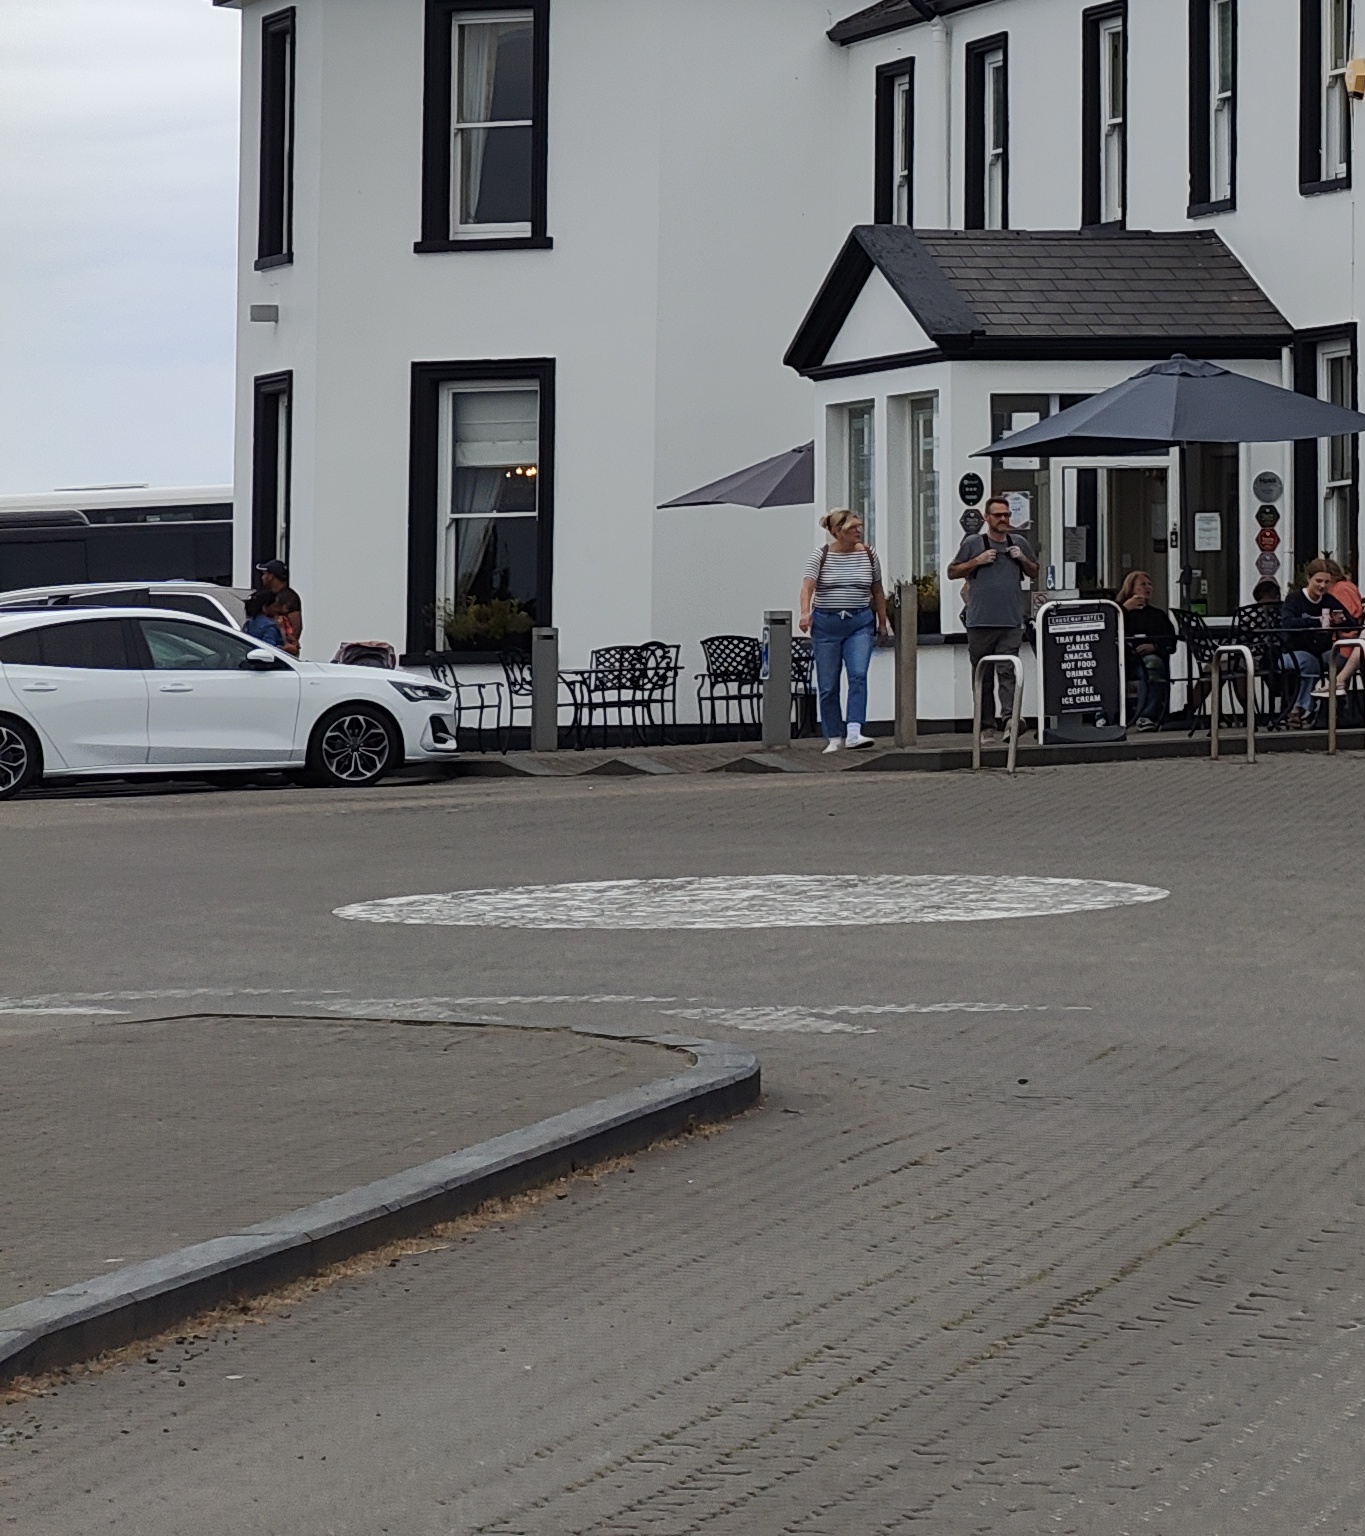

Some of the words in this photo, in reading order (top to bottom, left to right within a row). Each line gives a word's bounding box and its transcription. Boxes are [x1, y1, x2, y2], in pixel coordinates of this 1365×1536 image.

[1076, 634, 1099, 642] BAKES
[1064, 652, 1092, 660] SNACKS
[1078, 660, 1096, 668] FOOD
[1066, 669, 1093, 678] DRINKS
[1073, 678, 1088, 686] TEA
[1067, 686, 1094, 695] COFFEE
[1076, 695, 1101, 703] CREAM
